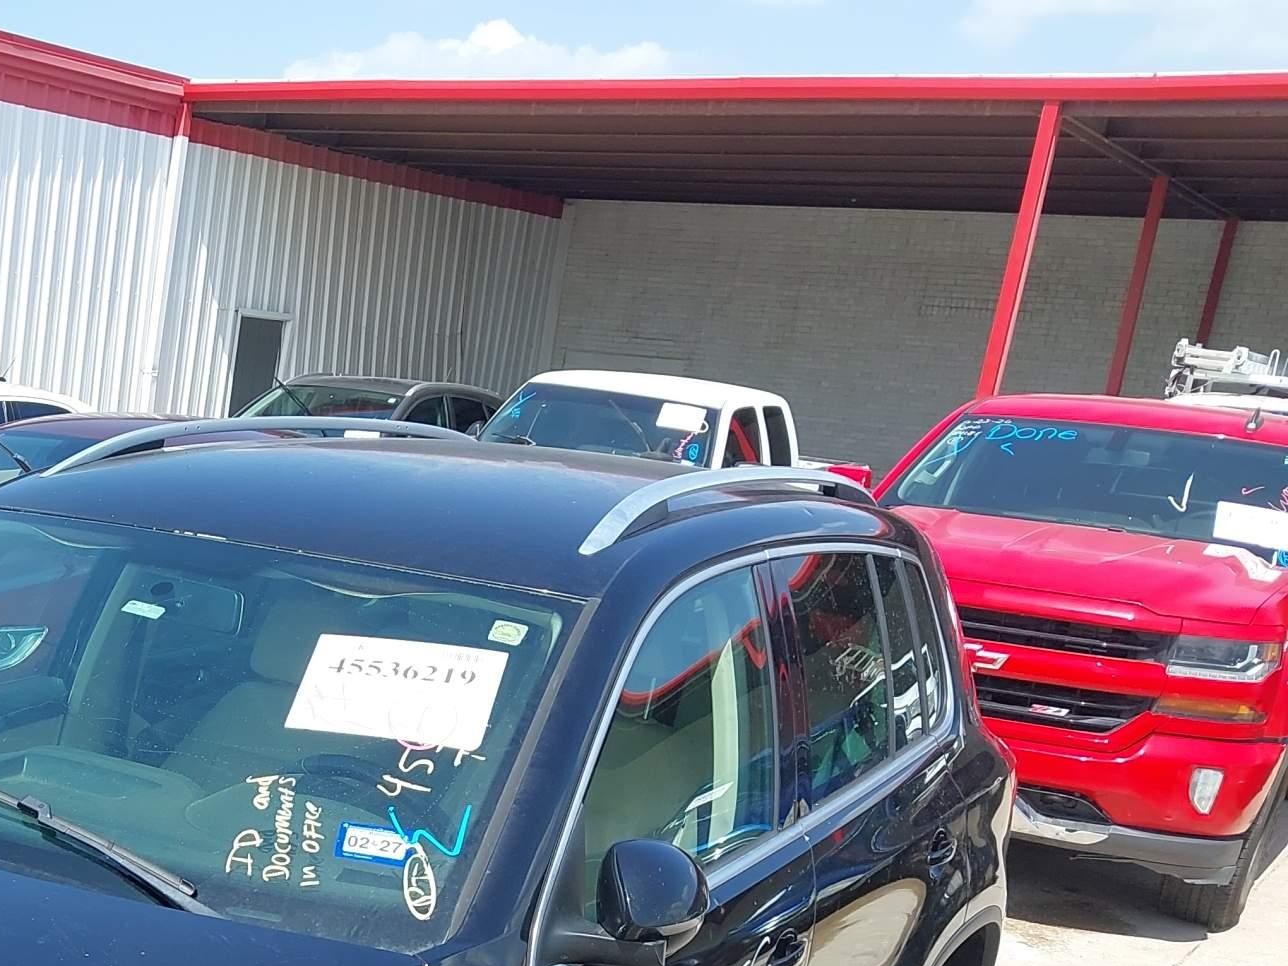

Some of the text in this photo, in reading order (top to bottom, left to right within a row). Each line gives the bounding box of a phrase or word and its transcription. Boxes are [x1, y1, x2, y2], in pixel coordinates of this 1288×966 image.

[985, 423, 1078, 441] Done
[328, 657, 477, 685] 45536219
[245, 775, 280, 810] and
